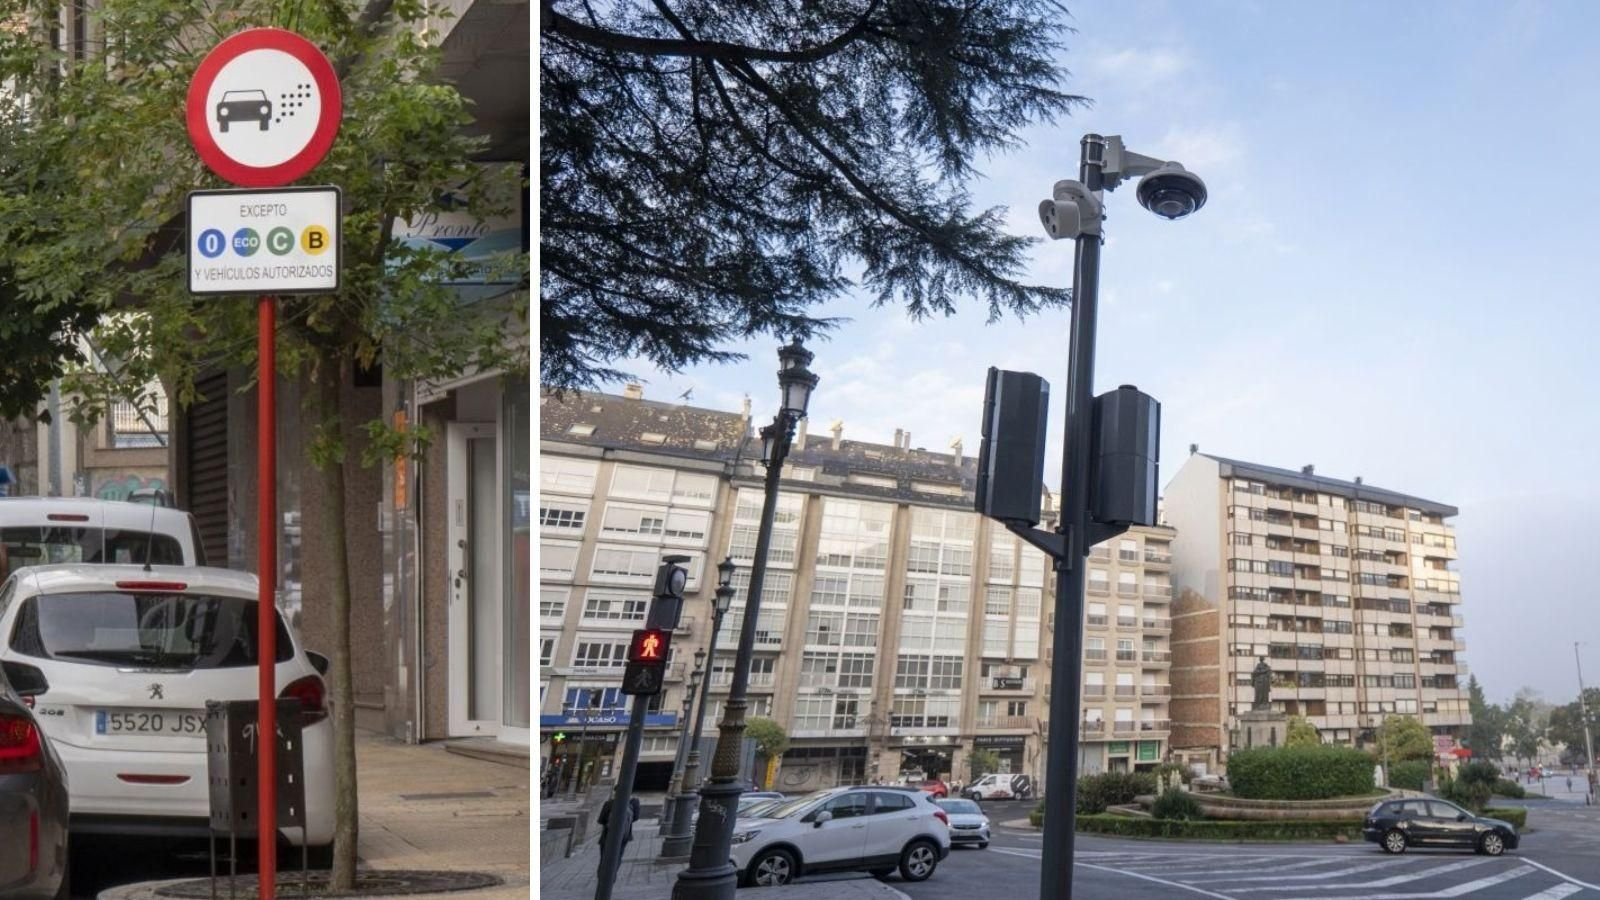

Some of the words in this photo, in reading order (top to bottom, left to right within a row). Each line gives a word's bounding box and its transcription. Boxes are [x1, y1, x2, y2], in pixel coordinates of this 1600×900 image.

[240, 203, 287, 217] EXCEPTO
[205, 234, 219, 253] 0
[234, 236, 259, 248] ECO
[272, 232, 289, 251] C
[308, 231, 323, 249] B
[194, 268, 202, 280] Y
[204, 266, 260, 280] VEHÍCULOS
[261, 265, 334, 279] AUTORIZADOS
[111, 713, 163, 732] 5520
